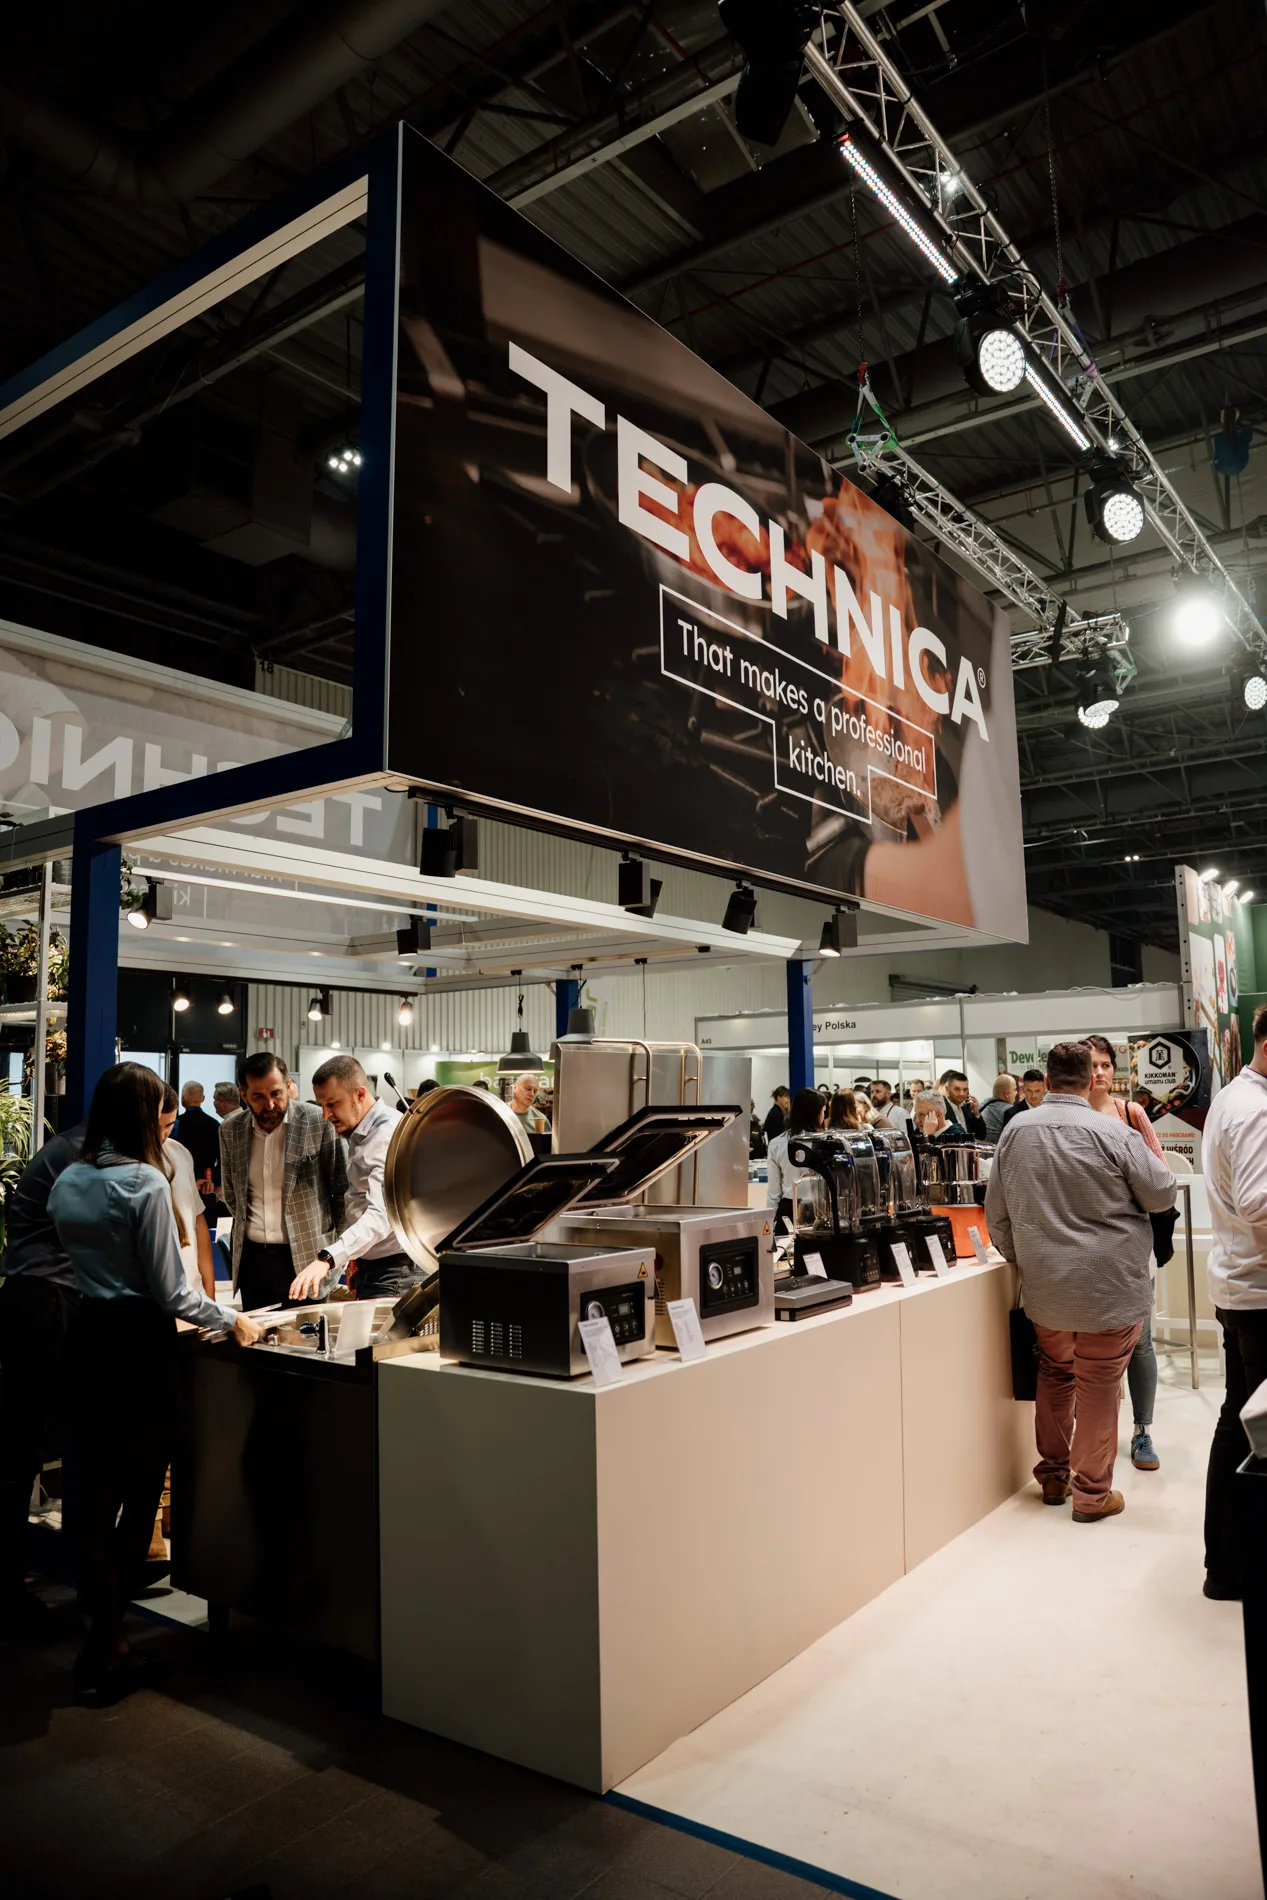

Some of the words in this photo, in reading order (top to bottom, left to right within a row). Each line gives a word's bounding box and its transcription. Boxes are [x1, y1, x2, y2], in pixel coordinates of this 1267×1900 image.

[677, 617, 734, 677] That
[740, 657, 809, 715] makes
[813, 697, 827, 724] a
[831, 704, 927, 775] professional
[788, 735, 862, 797] kitchen.
[825, 1020, 857, 1030] Polska
